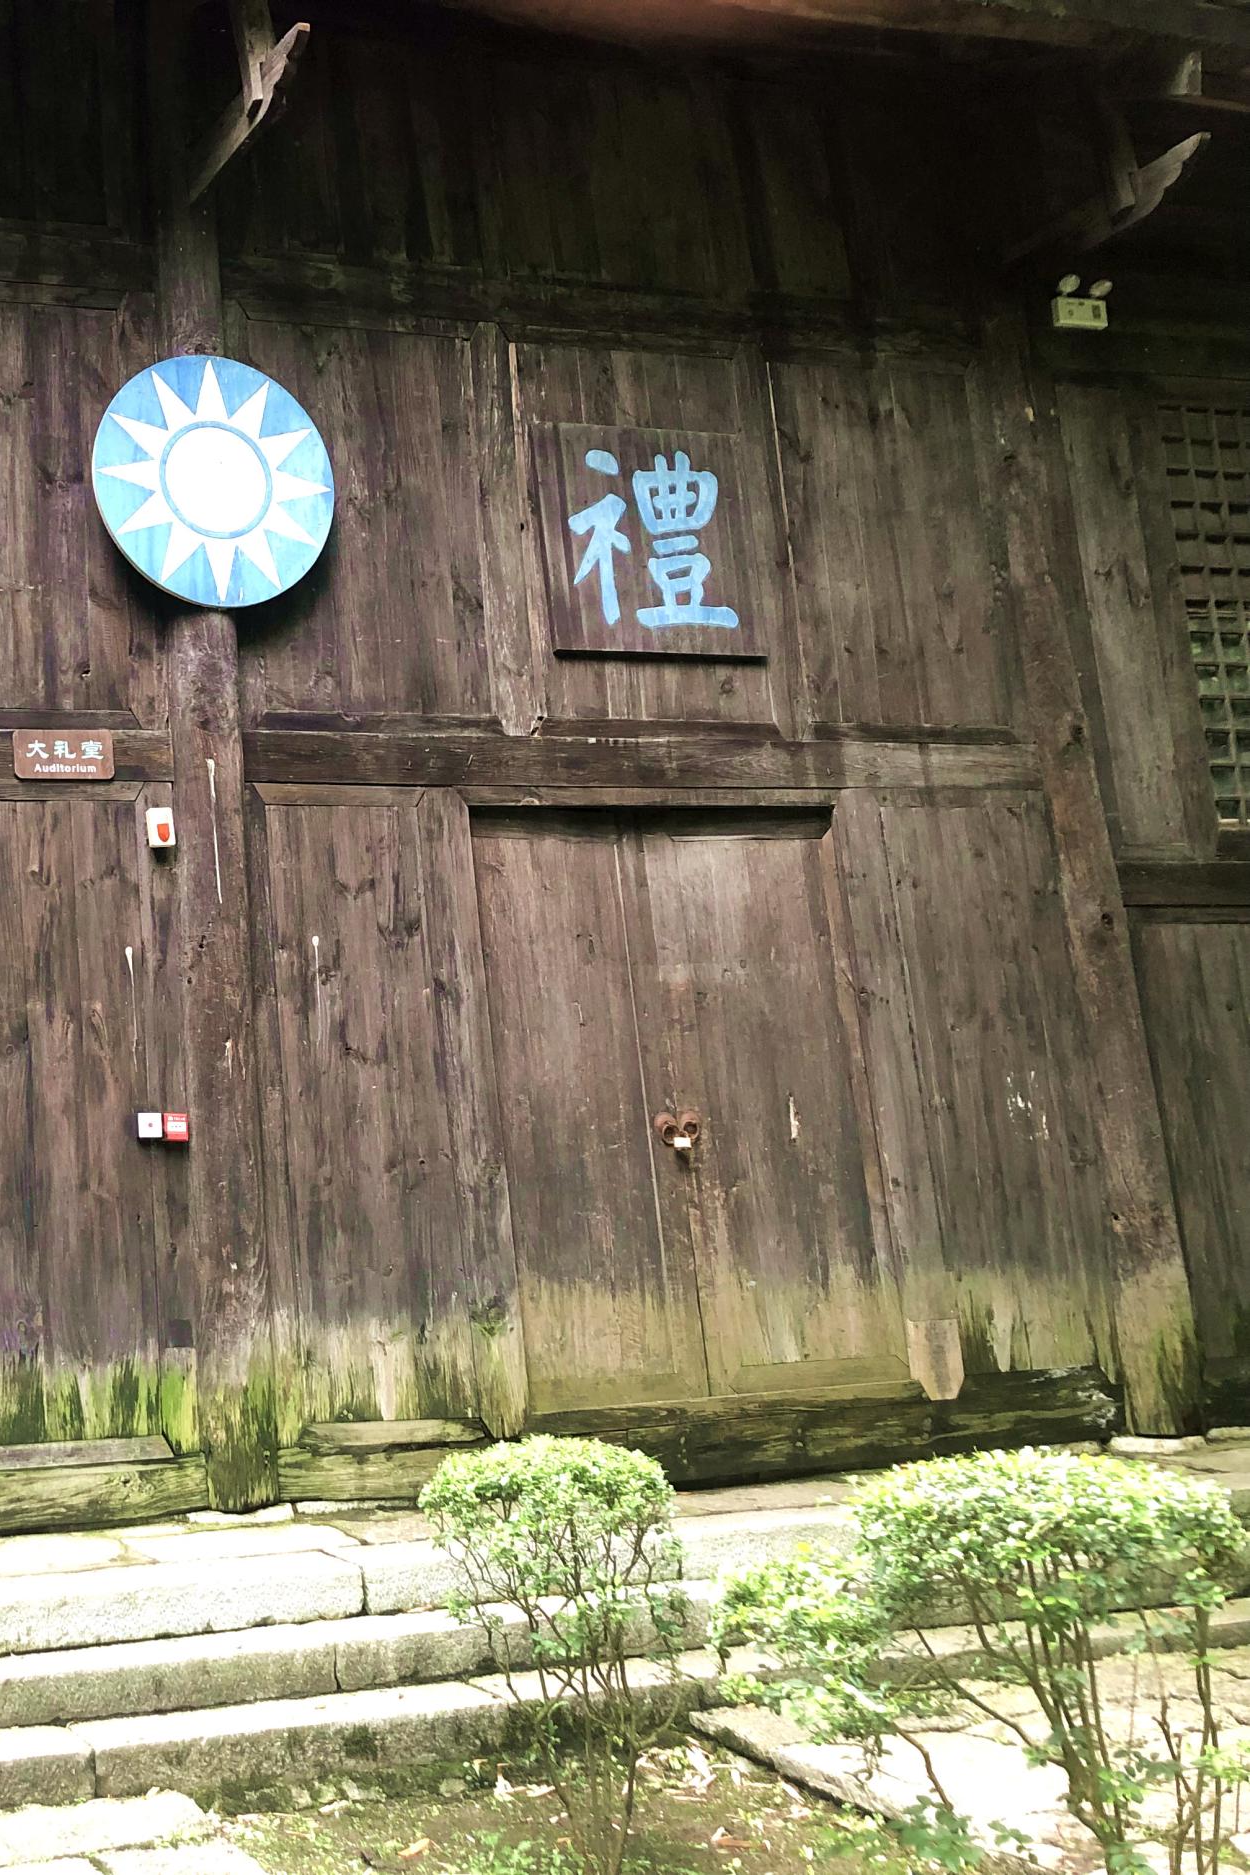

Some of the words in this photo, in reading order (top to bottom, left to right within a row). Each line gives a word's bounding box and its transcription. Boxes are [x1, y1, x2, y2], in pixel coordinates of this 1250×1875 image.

[568, 449, 739, 628] 禮
[26, 740, 104, 760] 大礼堂
[34, 763, 97, 773] Auditorium
